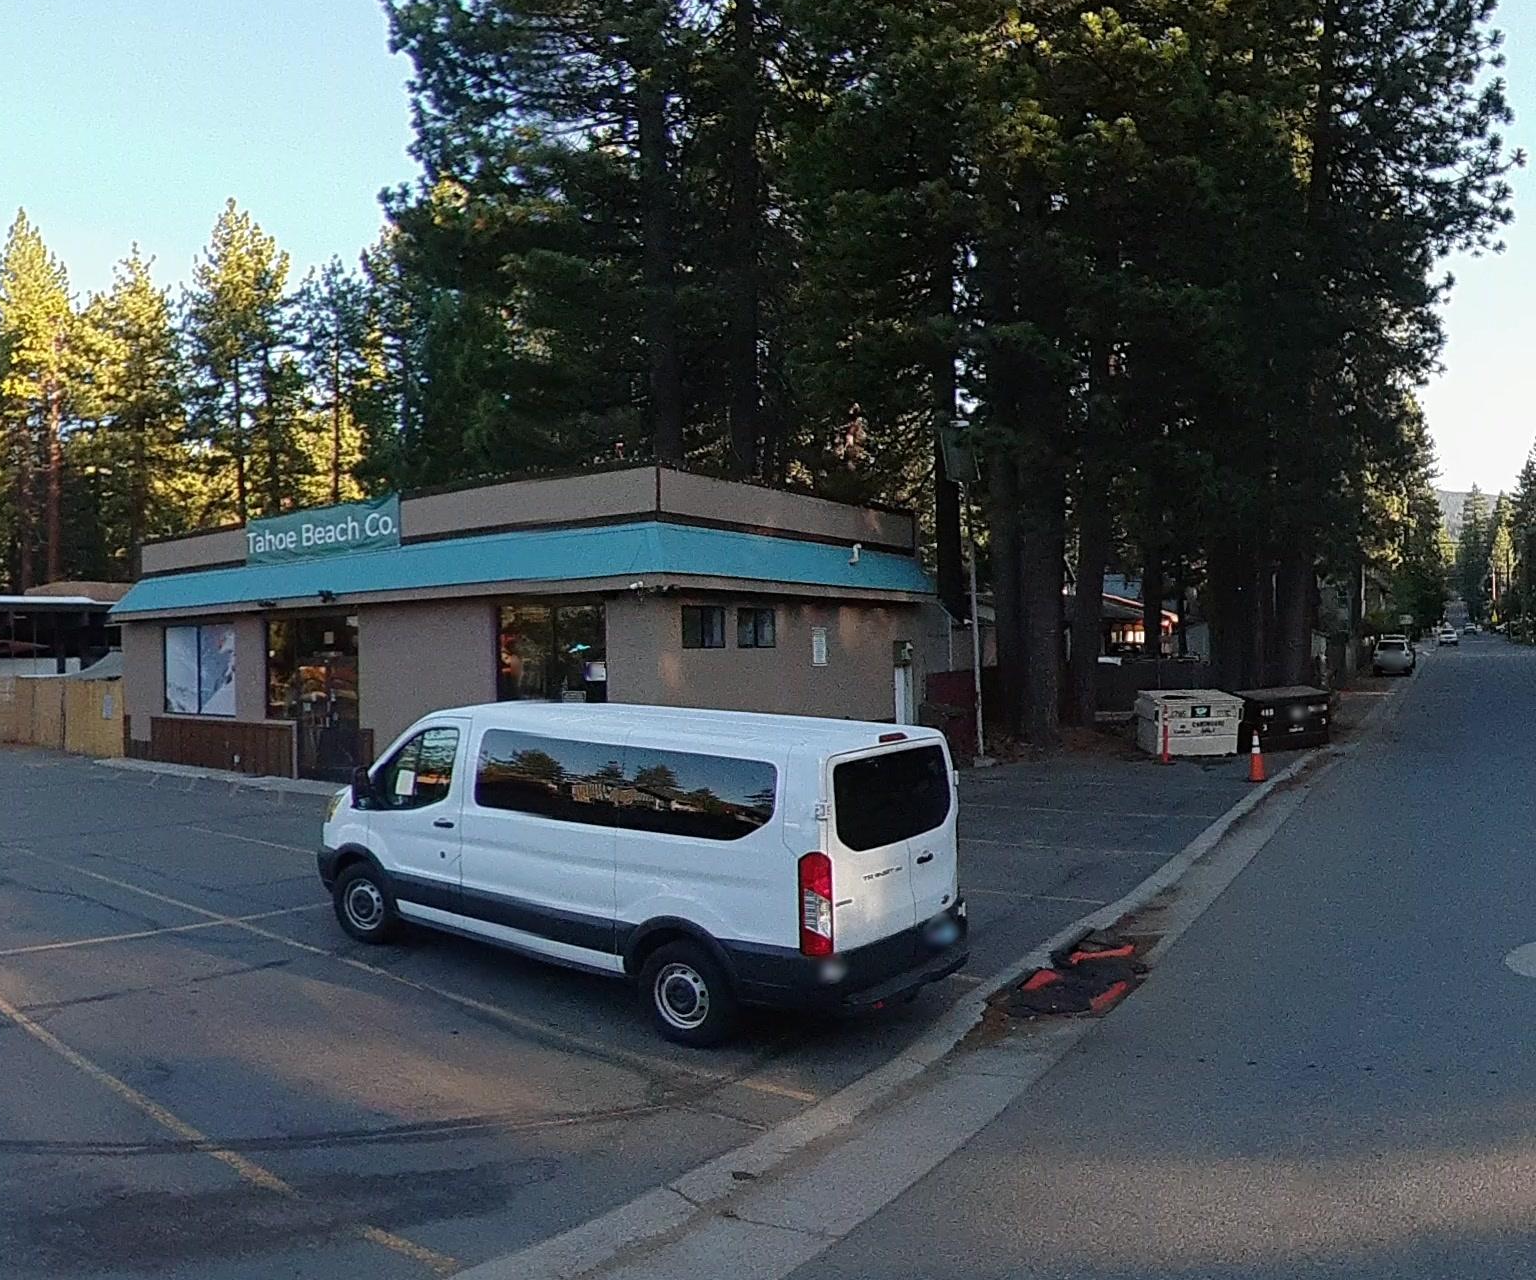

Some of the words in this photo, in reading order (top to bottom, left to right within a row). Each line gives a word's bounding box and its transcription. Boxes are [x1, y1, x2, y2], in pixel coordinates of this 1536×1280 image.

[247, 529, 297, 554] Tahoe
[302, 516, 359, 547] Beach
[365, 512, 398, 538] Co.
